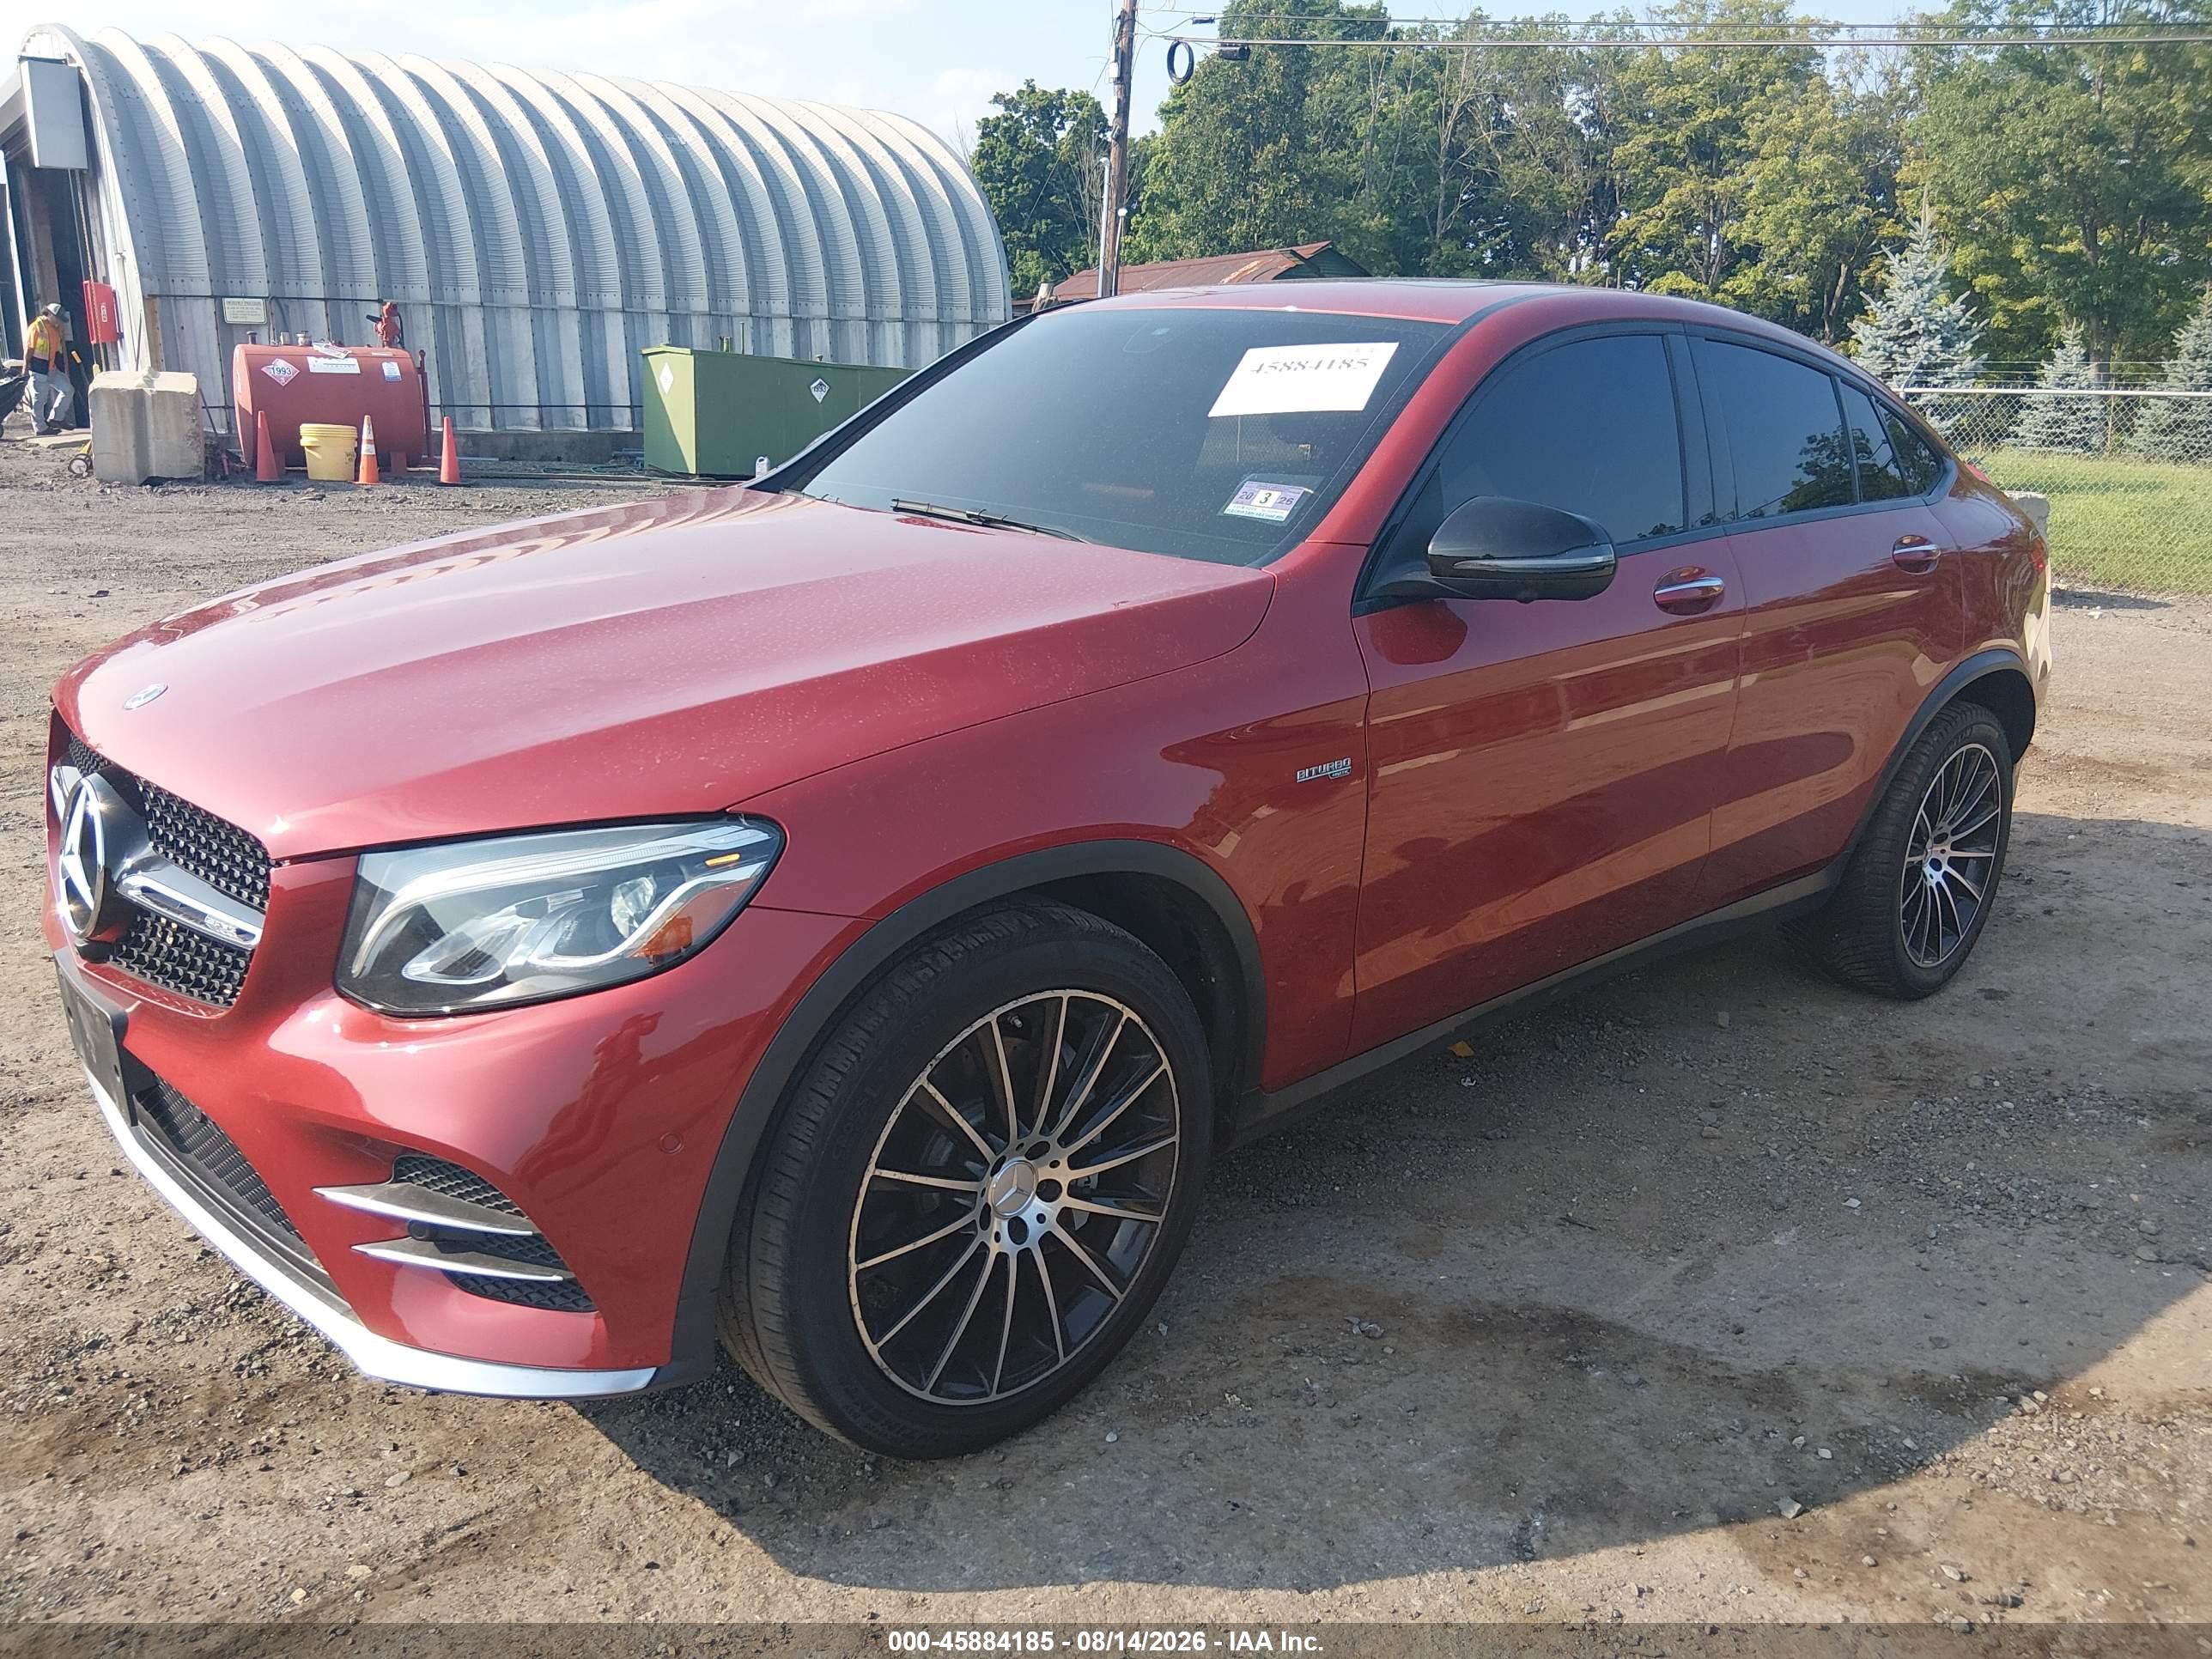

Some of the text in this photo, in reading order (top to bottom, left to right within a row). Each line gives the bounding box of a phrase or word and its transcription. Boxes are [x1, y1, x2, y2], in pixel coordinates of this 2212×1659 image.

[270, 367, 292, 375] 1993
[1250, 358, 1369, 374] 45884185
[1238, 491, 1294, 506] 20 3 26
[1297, 757, 1352, 780] BITURBO
